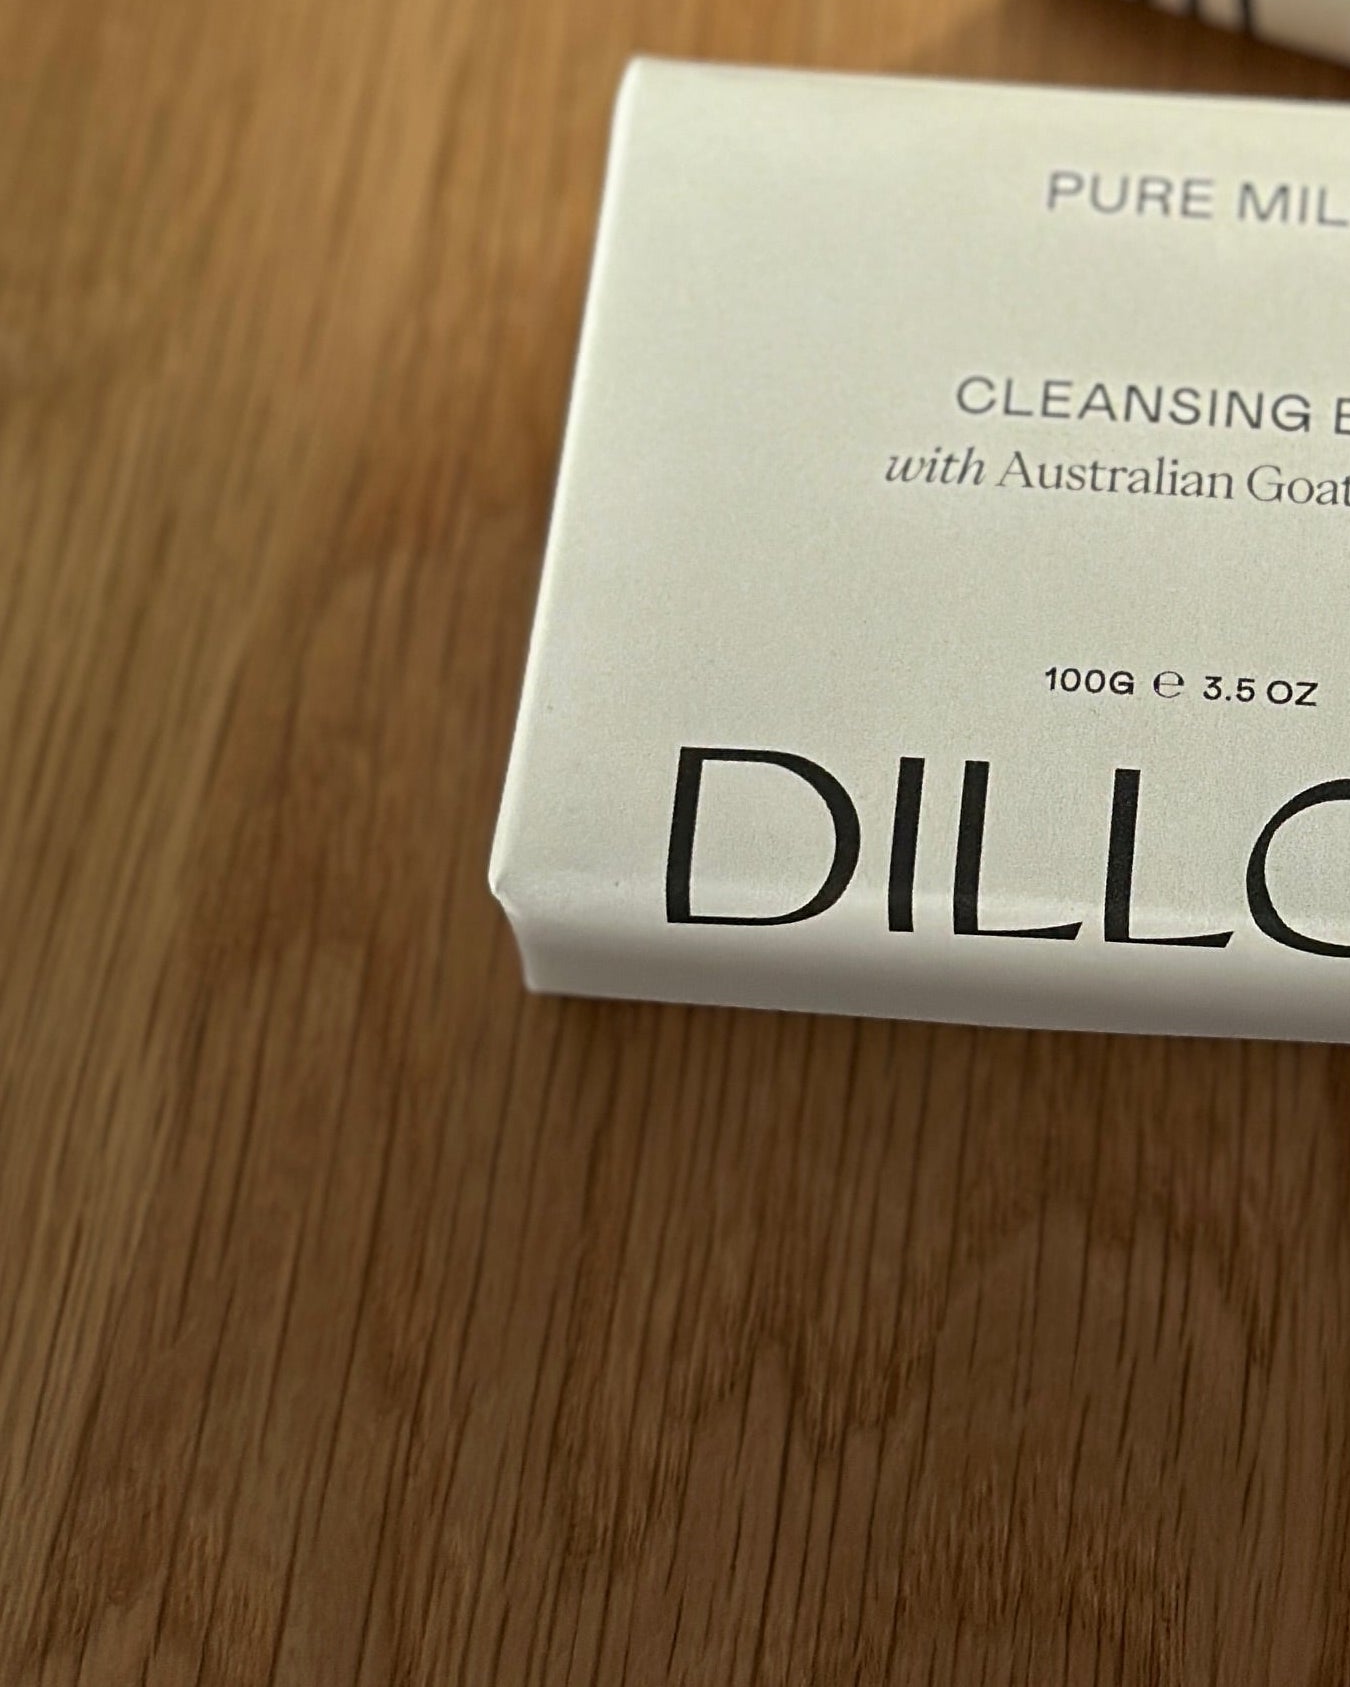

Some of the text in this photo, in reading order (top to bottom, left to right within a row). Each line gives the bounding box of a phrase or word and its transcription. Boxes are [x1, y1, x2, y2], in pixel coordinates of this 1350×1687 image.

[1045, 170, 1215, 220] PURE
[955, 375, 1312, 434] CLEANSING
[884, 445, 986, 487] with
[995, 449, 1235, 501] Australian
[1043, 665, 1136, 697] 100G
[1202, 673, 1257, 704] 3.5
[1265, 678, 1319, 708] OZ
